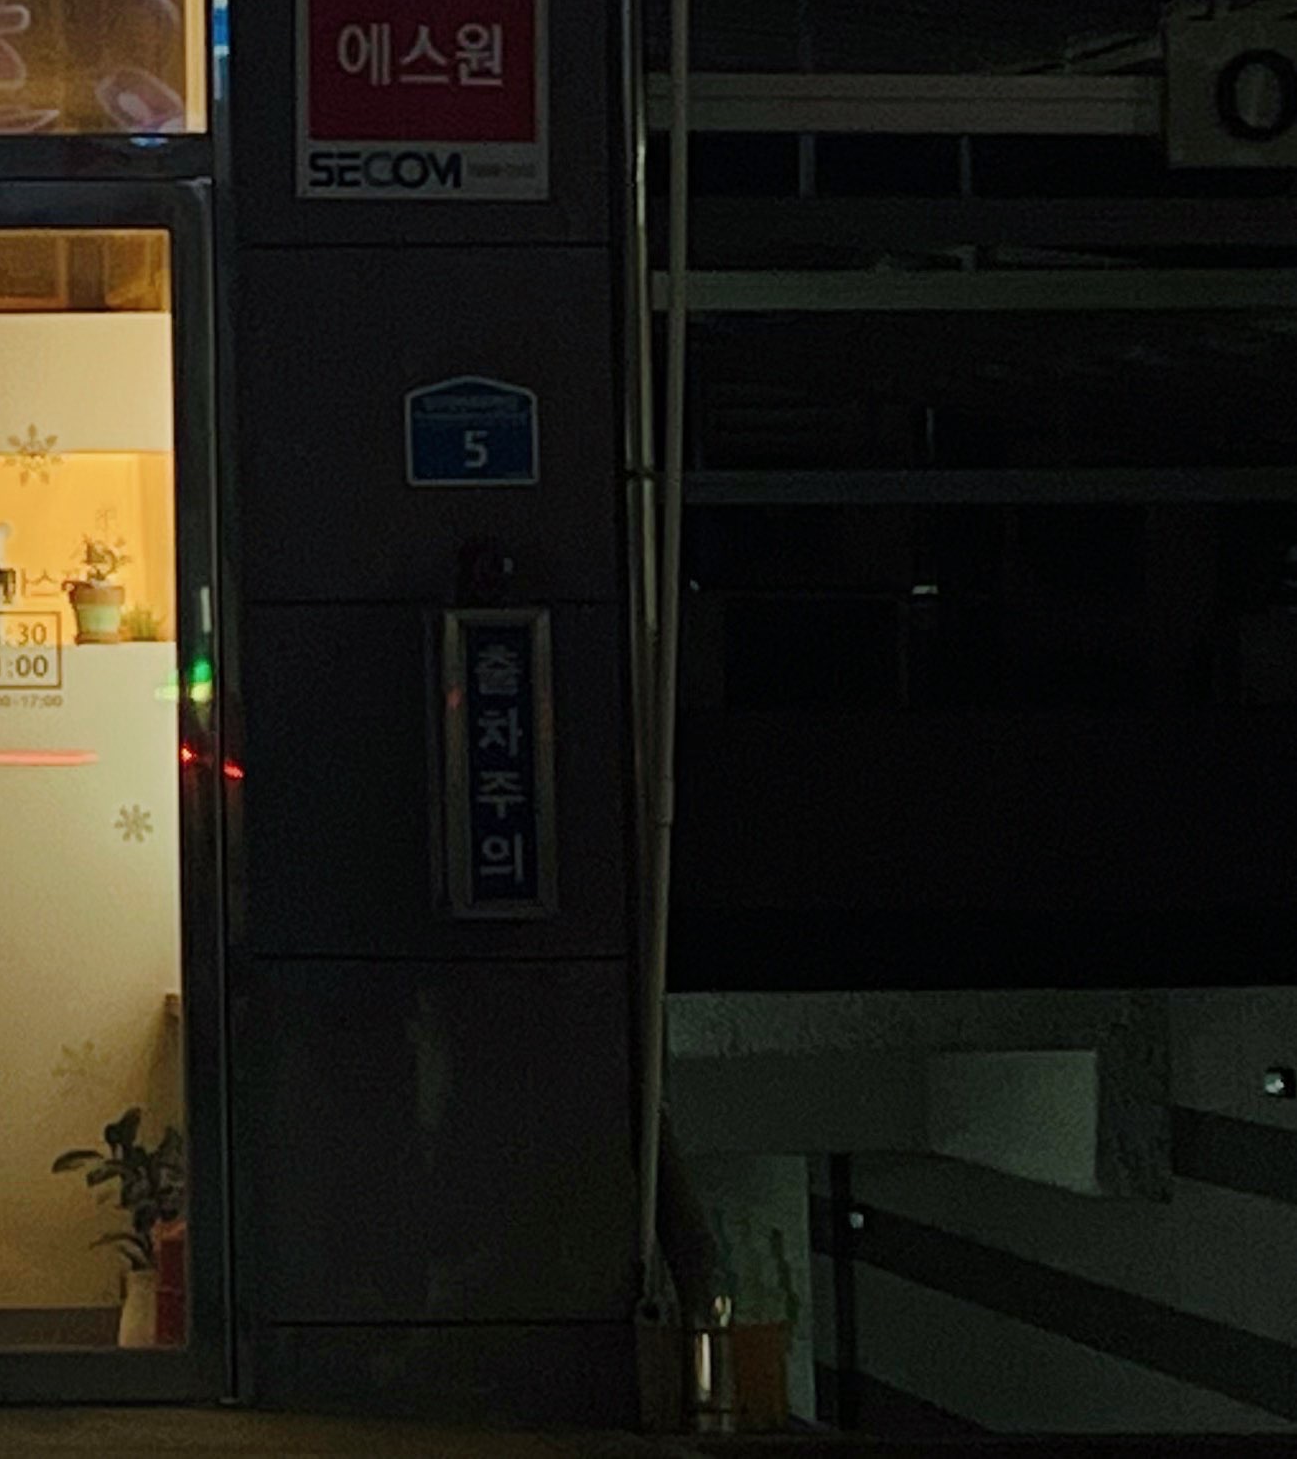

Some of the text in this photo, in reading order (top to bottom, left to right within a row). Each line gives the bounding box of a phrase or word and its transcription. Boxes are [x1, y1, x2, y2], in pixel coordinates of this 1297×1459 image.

[336, 20, 504, 87] 에스원
[309, 151, 461, 189] SECOM
[463, 429, 490, 469] 5
